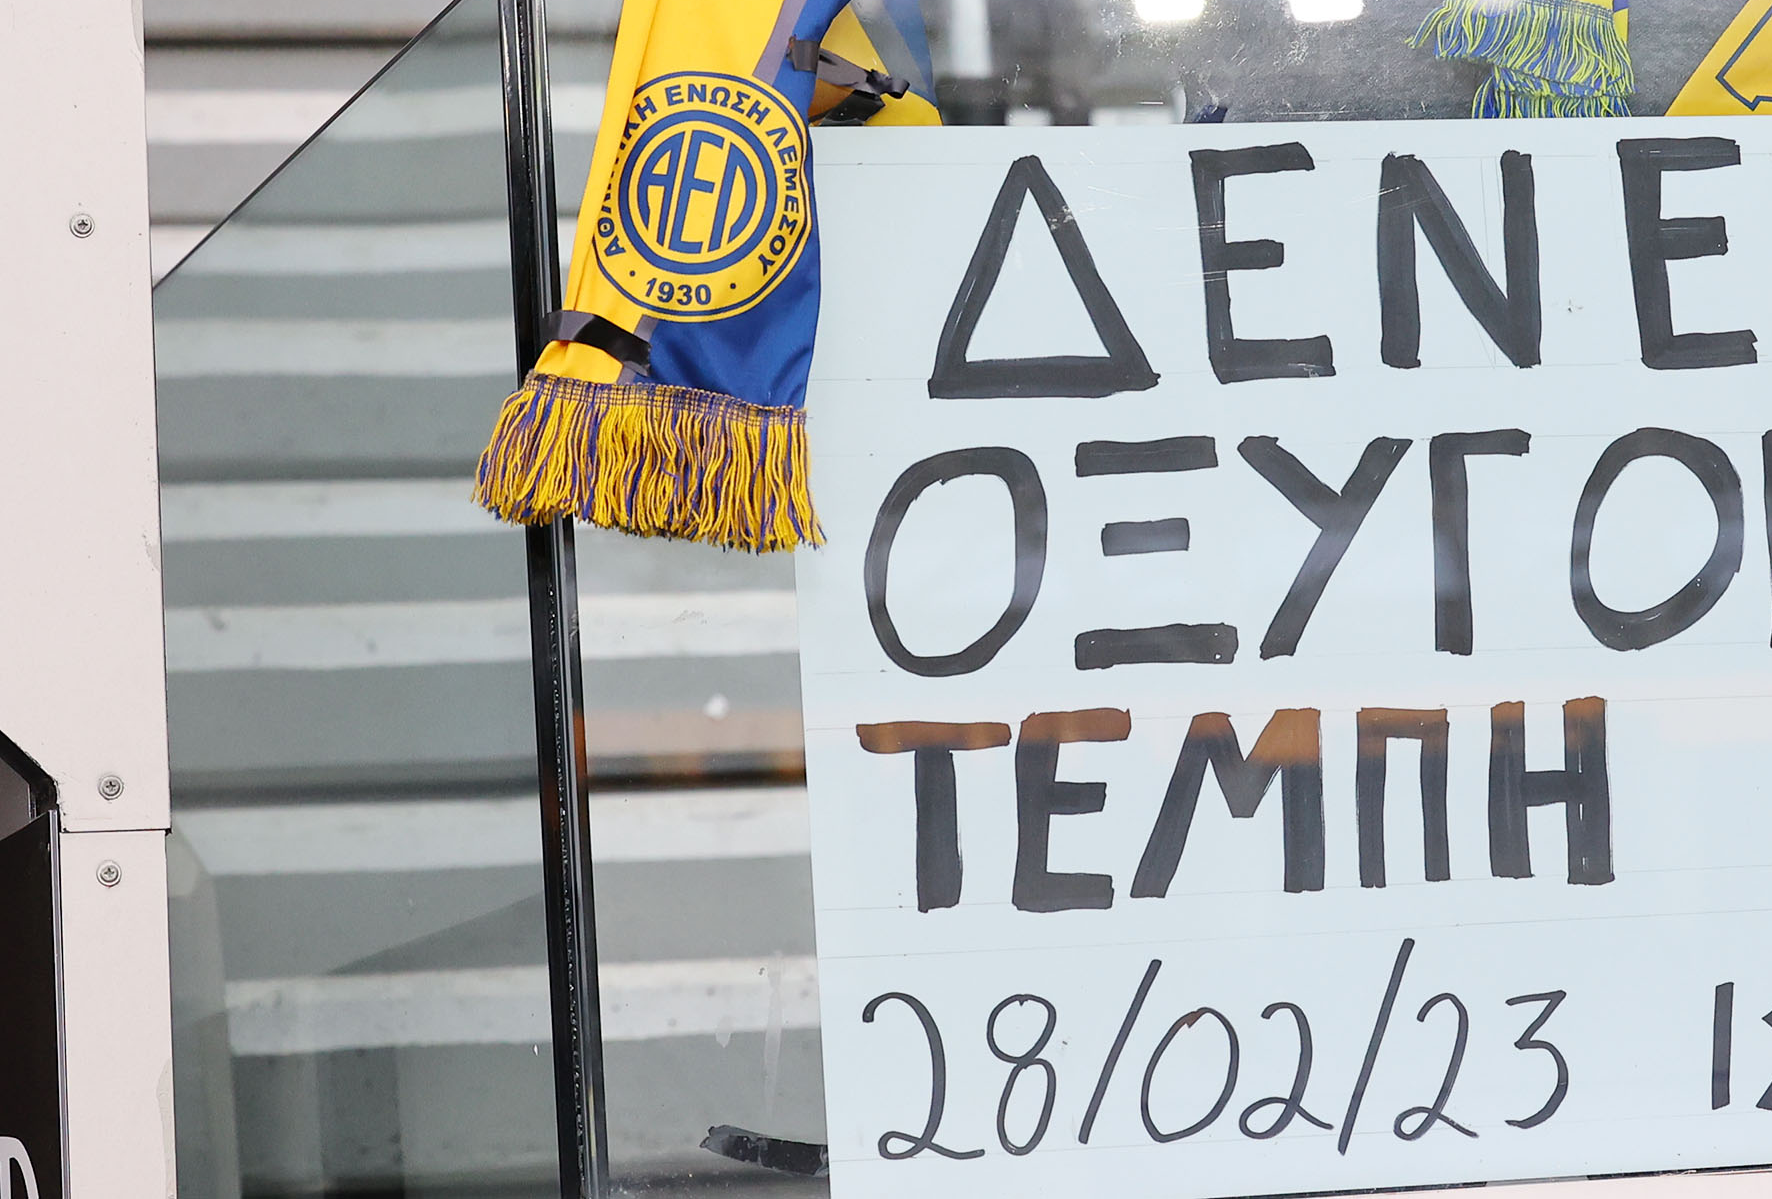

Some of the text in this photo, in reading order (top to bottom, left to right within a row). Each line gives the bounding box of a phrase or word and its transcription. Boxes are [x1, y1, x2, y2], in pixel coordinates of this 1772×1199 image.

[664, 83, 771, 126] ΕΝΩΣΗ
[758, 126, 800, 276] ΛΕΜΕΣΟΥ
[927, 142, 1542, 399] ΔΕΝ
[645, 277, 711, 306] 1930
[856, 695, 1616, 913] ΤΕΜΠΗ
[862, 937, 1569, 1160] 28/02/23
